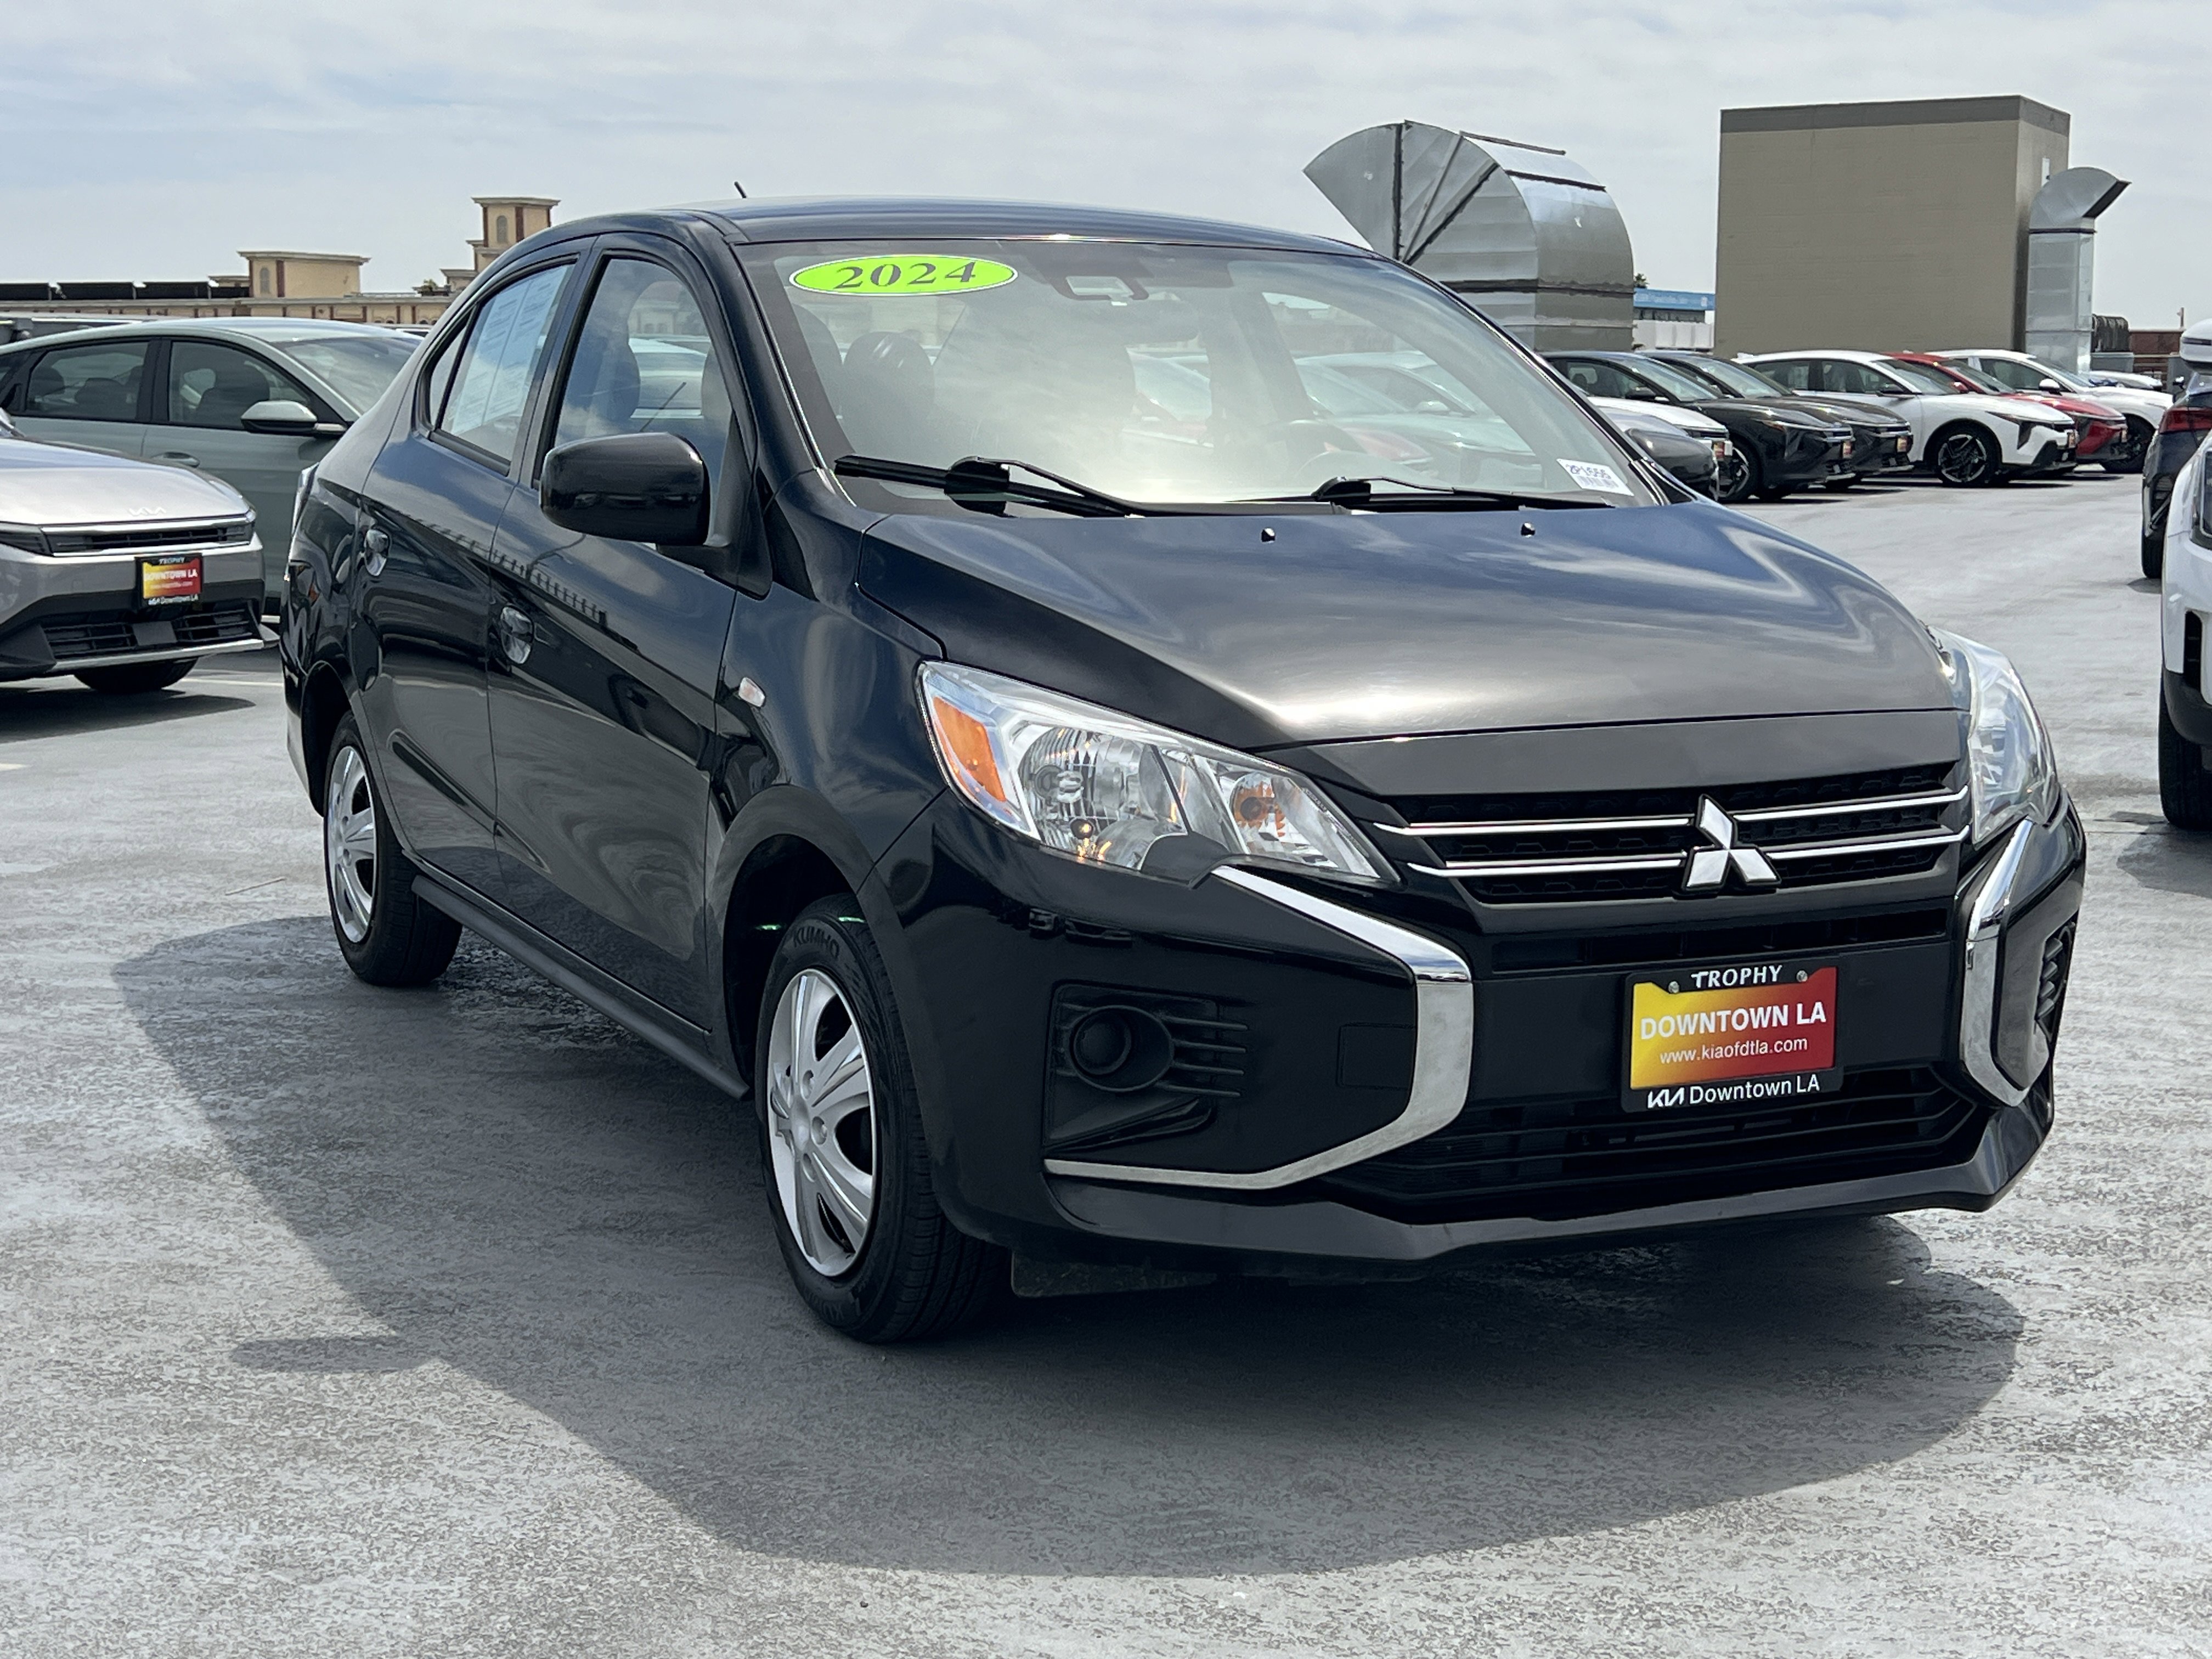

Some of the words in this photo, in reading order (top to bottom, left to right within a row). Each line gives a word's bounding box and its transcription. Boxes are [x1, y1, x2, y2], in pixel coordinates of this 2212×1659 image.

[833, 261, 976, 289] 2024
[188, 569, 198, 577] LA
[1691, 964, 1782, 989] TROPHY
[1640, 1004, 1788, 1040] DOWNTOWN
[1796, 1001, 1826, 1025] LA
[1660, 1038, 1808, 1064] www.kiaofdtla.com
[1690, 1080, 1792, 1104] Downtown
[1796, 1073, 1820, 1093] LA
